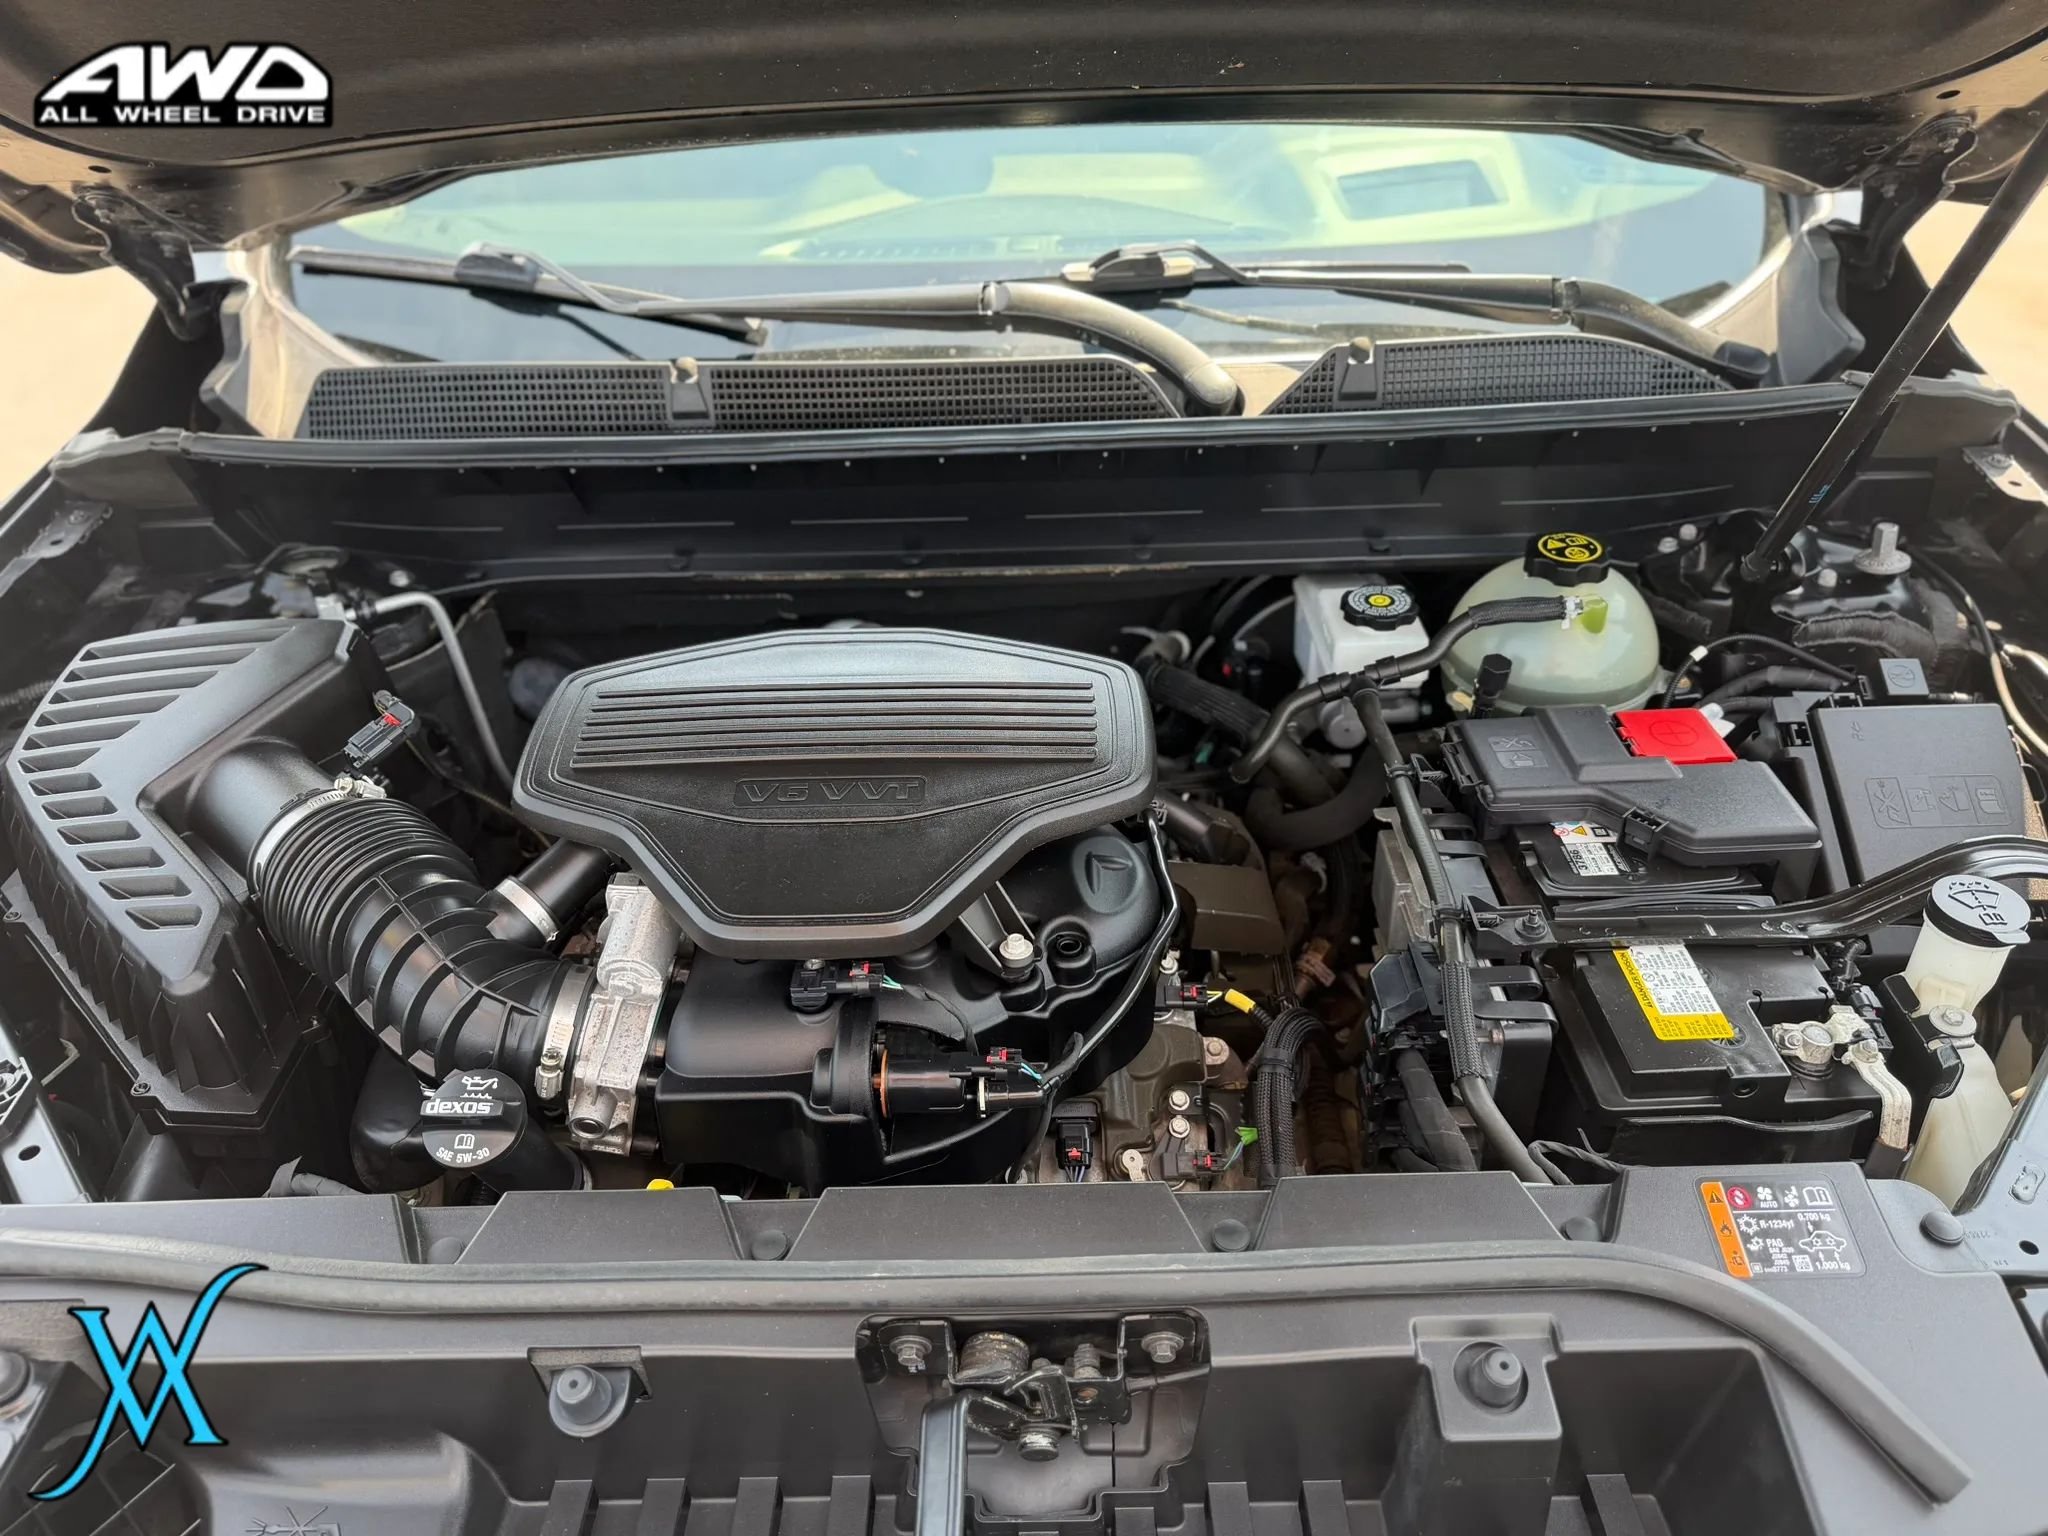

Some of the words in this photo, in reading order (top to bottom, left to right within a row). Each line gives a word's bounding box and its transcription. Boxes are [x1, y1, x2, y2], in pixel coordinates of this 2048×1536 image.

[743, 783, 809, 802] V6
[820, 781, 919, 800] VVT
[425, 1098, 494, 1114] dexos
[436, 1147, 455, 1162] SAE
[456, 1147, 491, 1163] 5W-30
[1760, 1201, 1778, 1209] AUTO
[1819, 1213, 1832, 1222] kg
